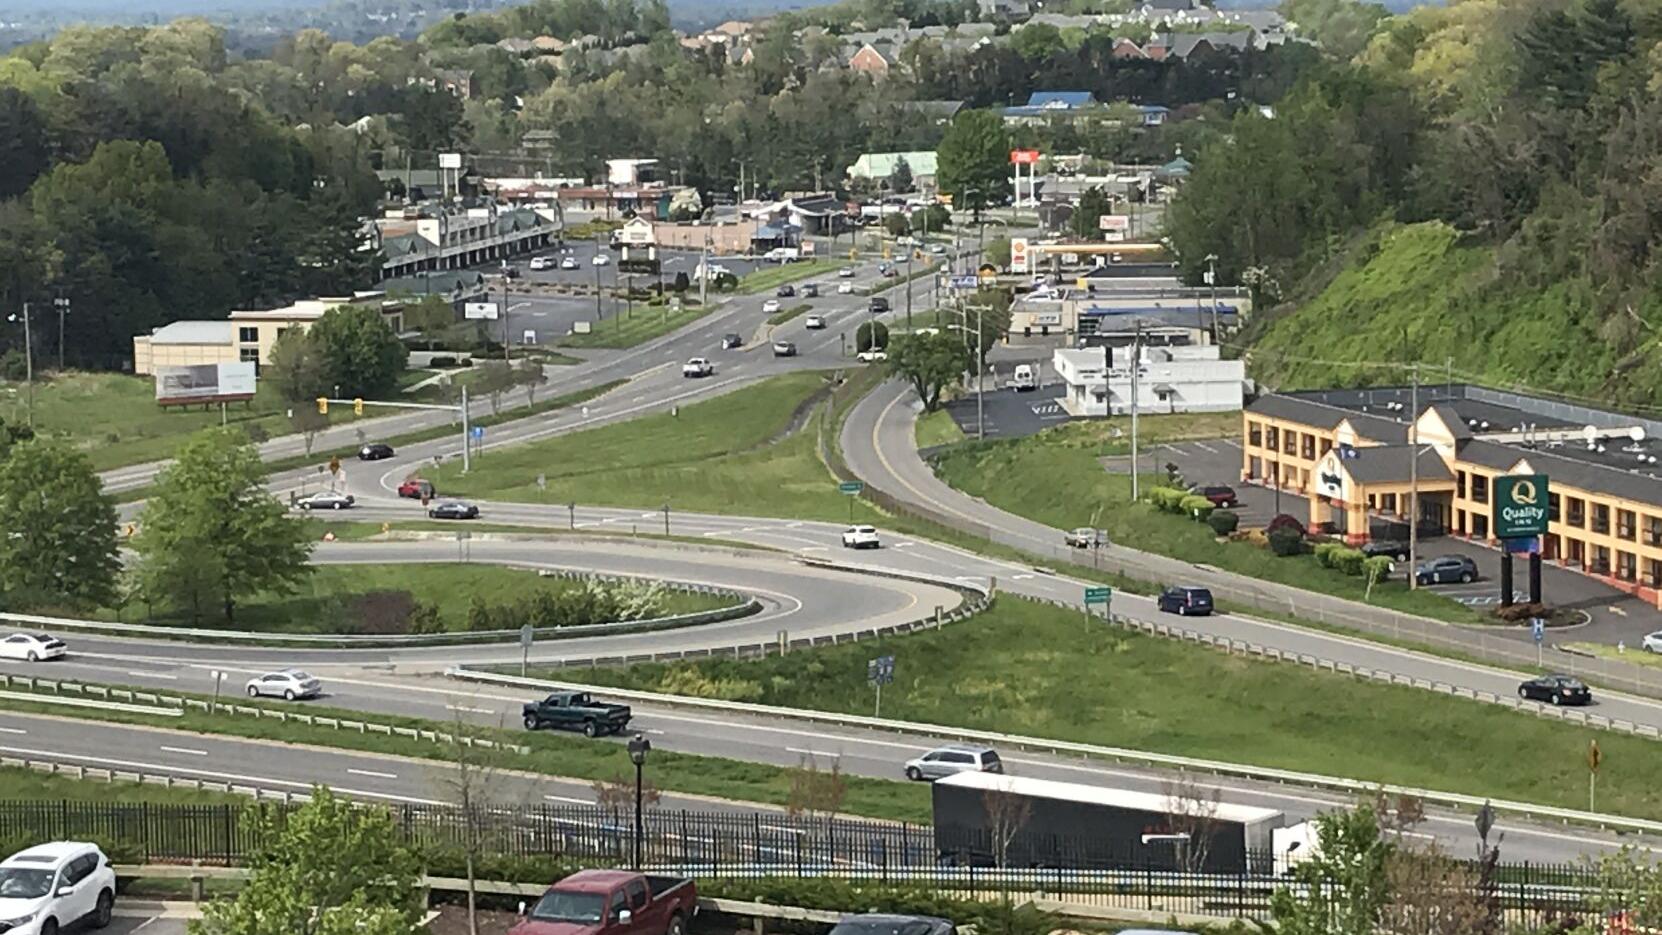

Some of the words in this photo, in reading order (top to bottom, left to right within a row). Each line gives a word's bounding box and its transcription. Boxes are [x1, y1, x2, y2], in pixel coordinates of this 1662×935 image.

[1511, 480, 1537, 504] Q
[1502, 506, 1544, 521] Quality
[1533, 618, 1545, 633] H
